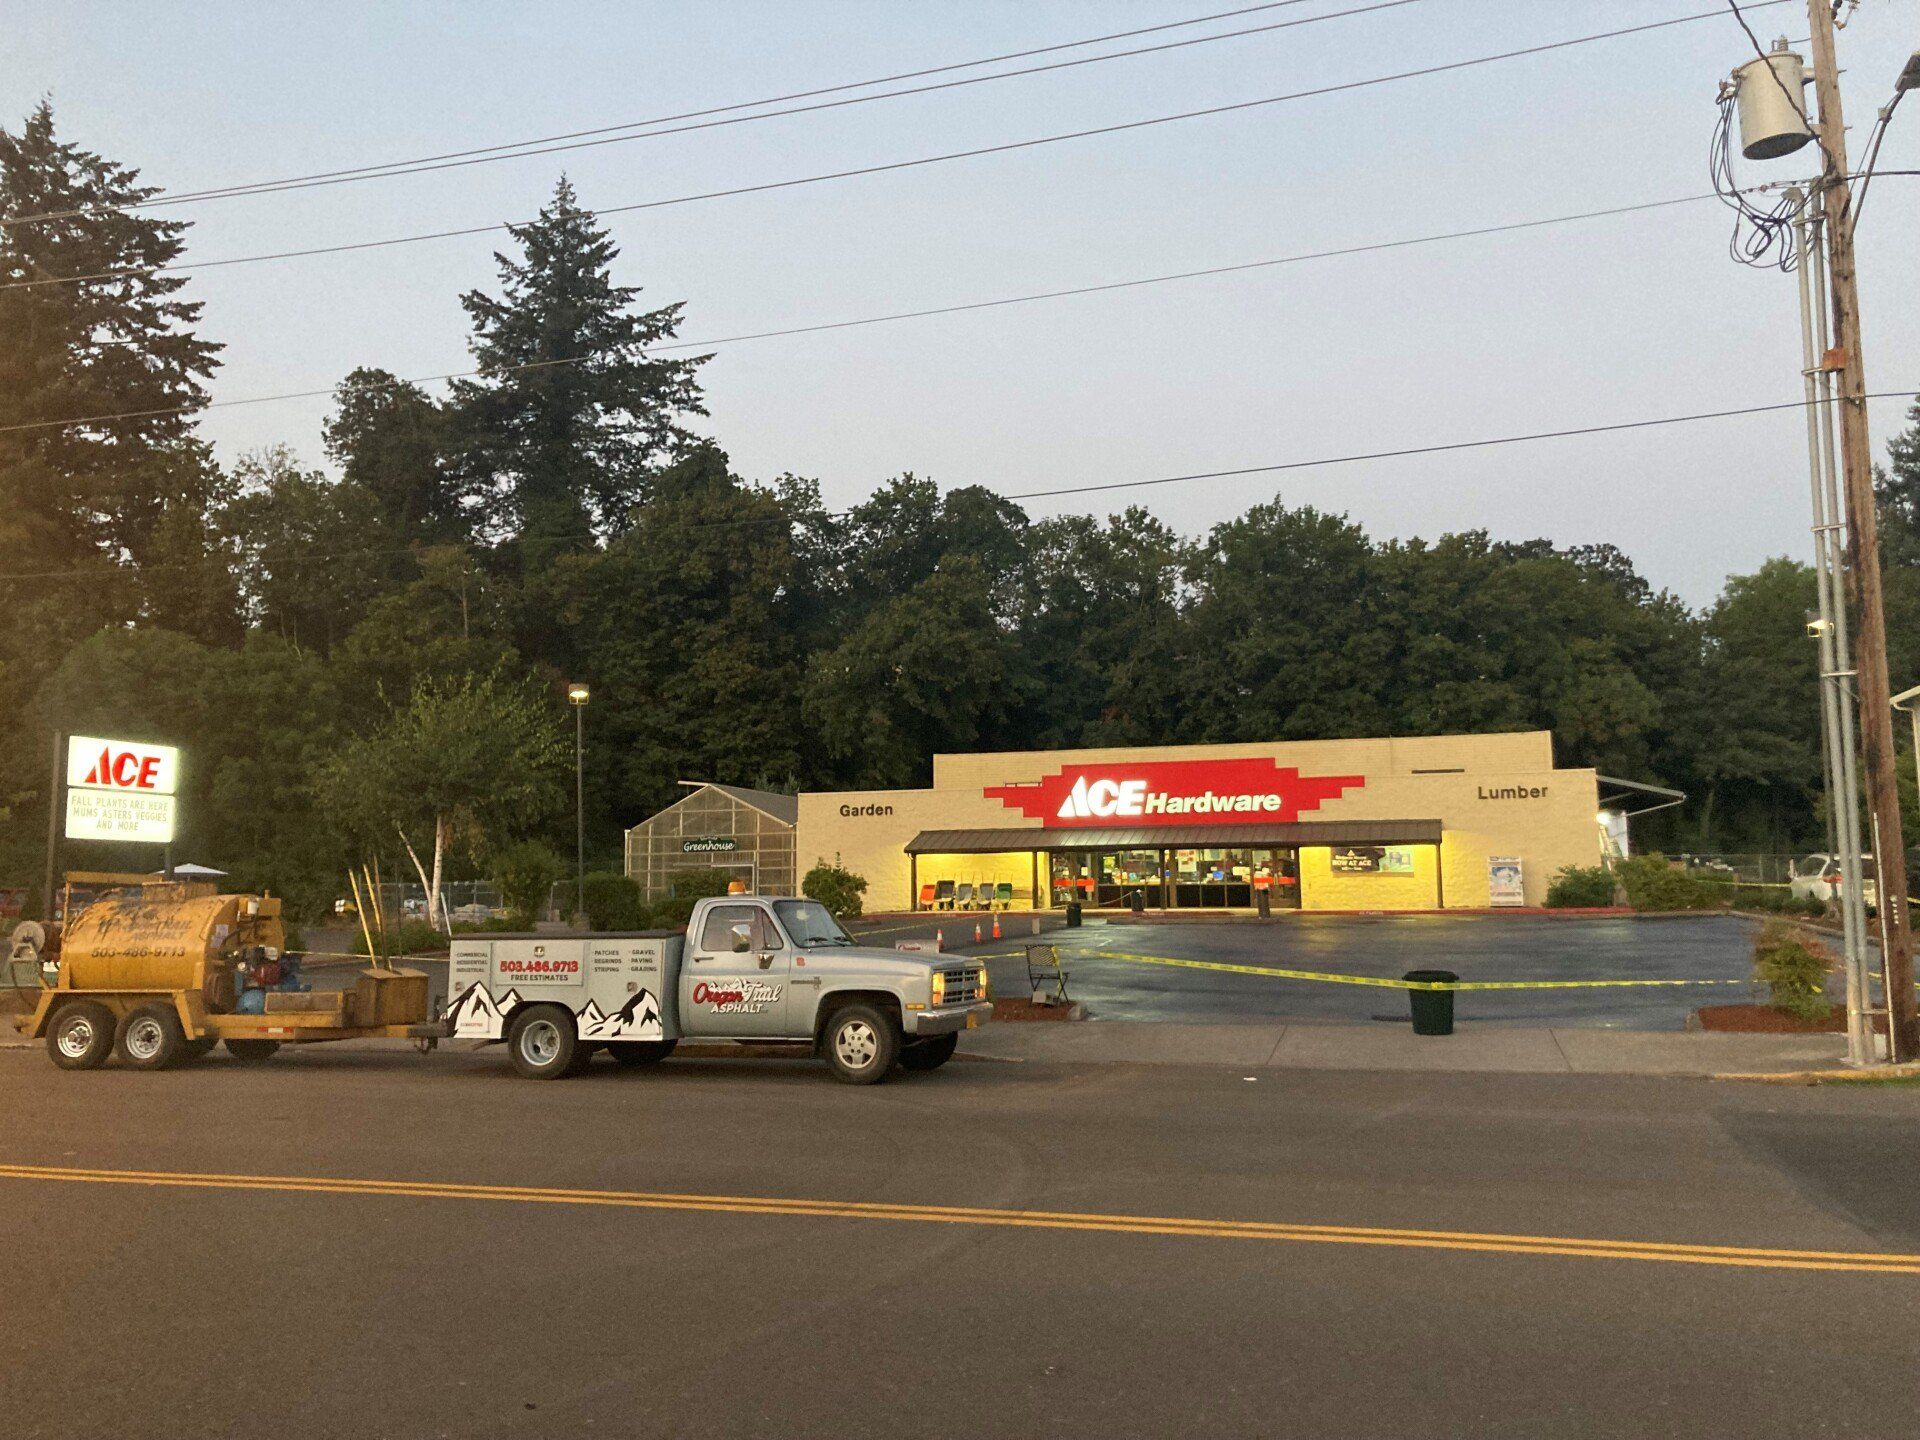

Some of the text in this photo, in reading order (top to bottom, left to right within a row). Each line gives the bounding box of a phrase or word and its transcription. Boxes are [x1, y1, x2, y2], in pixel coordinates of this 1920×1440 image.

[84, 746, 161, 789] ACE
[1057, 775, 1281, 817] ACE Hardware
[1478, 785, 1548, 799] Lumber
[72, 795, 168, 811] FALL PLANTS ARE HERE
[73, 807, 167, 822] MUMS ASTERS VEGGIES
[840, 804, 893, 817] Garden
[96, 820, 139, 831] AND MORE
[683, 841, 735, 852] Greenhouse
[500, 960, 579, 973] 503.486.9713
[744, 983, 783, 1003] Trail
[710, 1003, 764, 1014] ASPHALT
